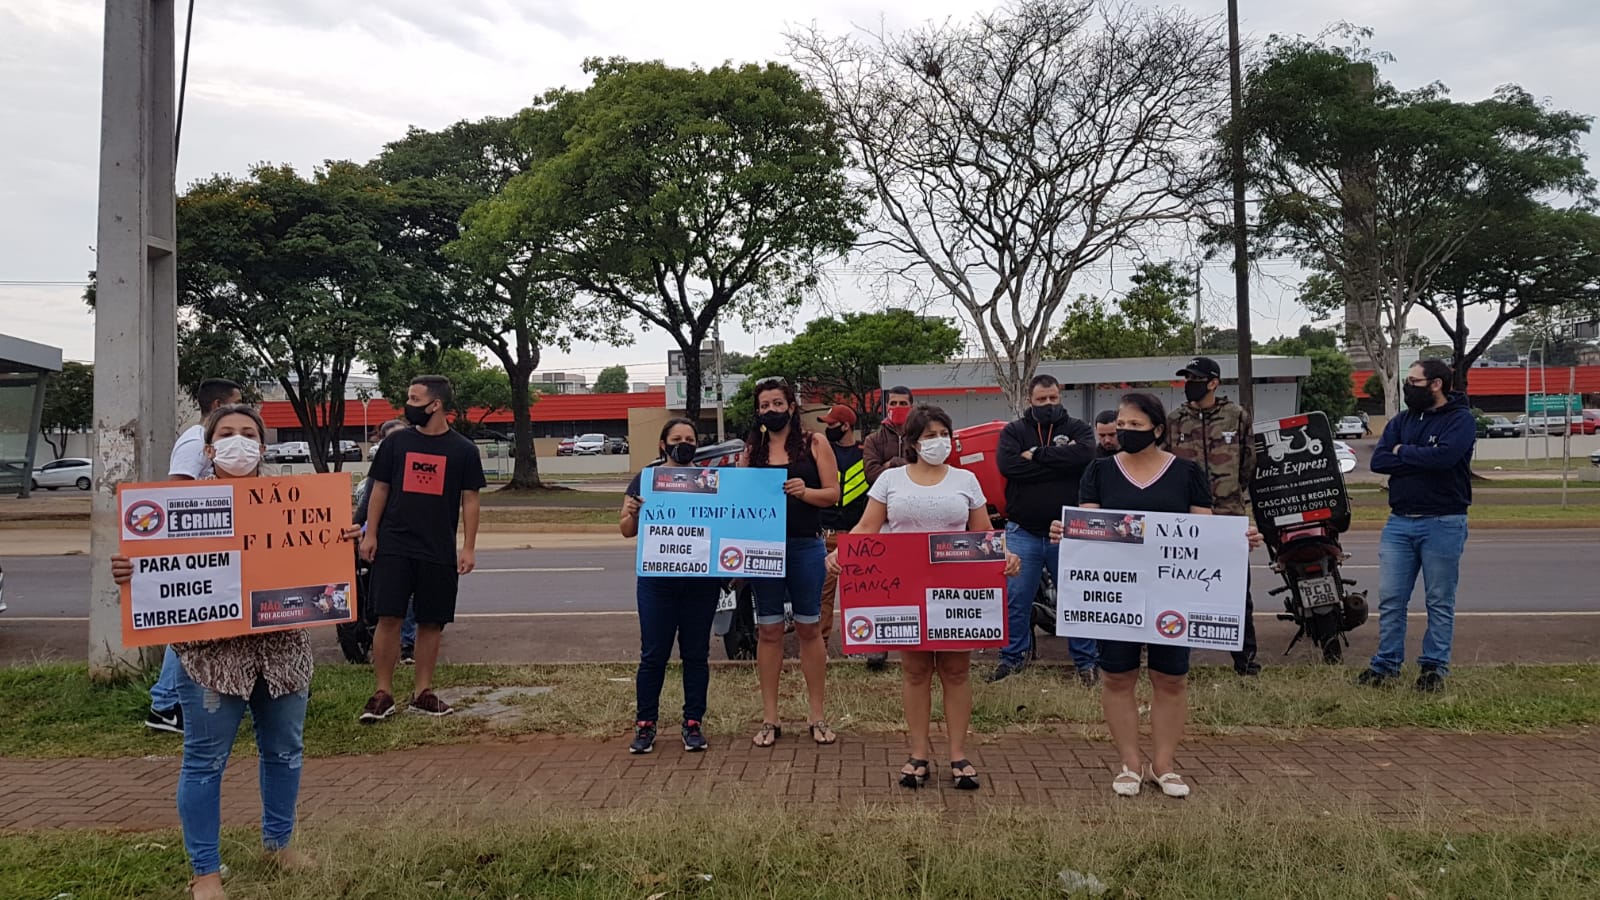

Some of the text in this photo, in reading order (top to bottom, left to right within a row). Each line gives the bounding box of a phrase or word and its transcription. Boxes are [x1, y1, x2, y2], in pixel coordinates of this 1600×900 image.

[413, 461, 437, 473] DGK
[1256, 458, 1328, 479] Luiz Express
[249, 481, 300, 505] NÃO
[1258, 496, 1300, 508] CASCAVEL
[1308, 489, 1339, 499] REGIÃO
[169, 500, 198, 508] DIREÇÃO
[644, 502, 676, 521] NÃO
[1264, 508, 1279, 518] (45)
[1309, 500, 1327, 509] 0991
[170, 512, 230, 530] É CRIME
[282, 507, 332, 525] TEM
[650, 526, 704, 537] PARA QUEM
[1156, 517, 1199, 538] NÃO
[243, 528, 349, 550] FIANÇA
[660, 544, 692, 554] DIRIGE
[847, 538, 886, 557] NÃO
[1160, 546, 1198, 560] TEM
[140, 552, 230, 573] PARA QUEM
[643, 562, 708, 573] EMBREAGADO
[746, 556, 782, 570] É CRIME
[1070, 570, 1137, 583] PARA QUEM
[160, 579, 213, 599] DIRIGE
[843, 577, 900, 599] FIANÇA
[932, 590, 994, 600] PARA QUEM
[1304, 584, 1331, 596] BCD
[1083, 590, 1122, 604] DIRIGE
[1308, 592, 1335, 606] 1296
[134, 603, 239, 628] EMBREAGADO
[946, 608, 982, 619] DIRIGE
[1064, 610, 1143, 625] EMBREAGADO
[876, 625, 918, 637] É CRIME
[928, 628, 1001, 639] EMBREAGADO
[1190, 622, 1237, 639] É CRIME
